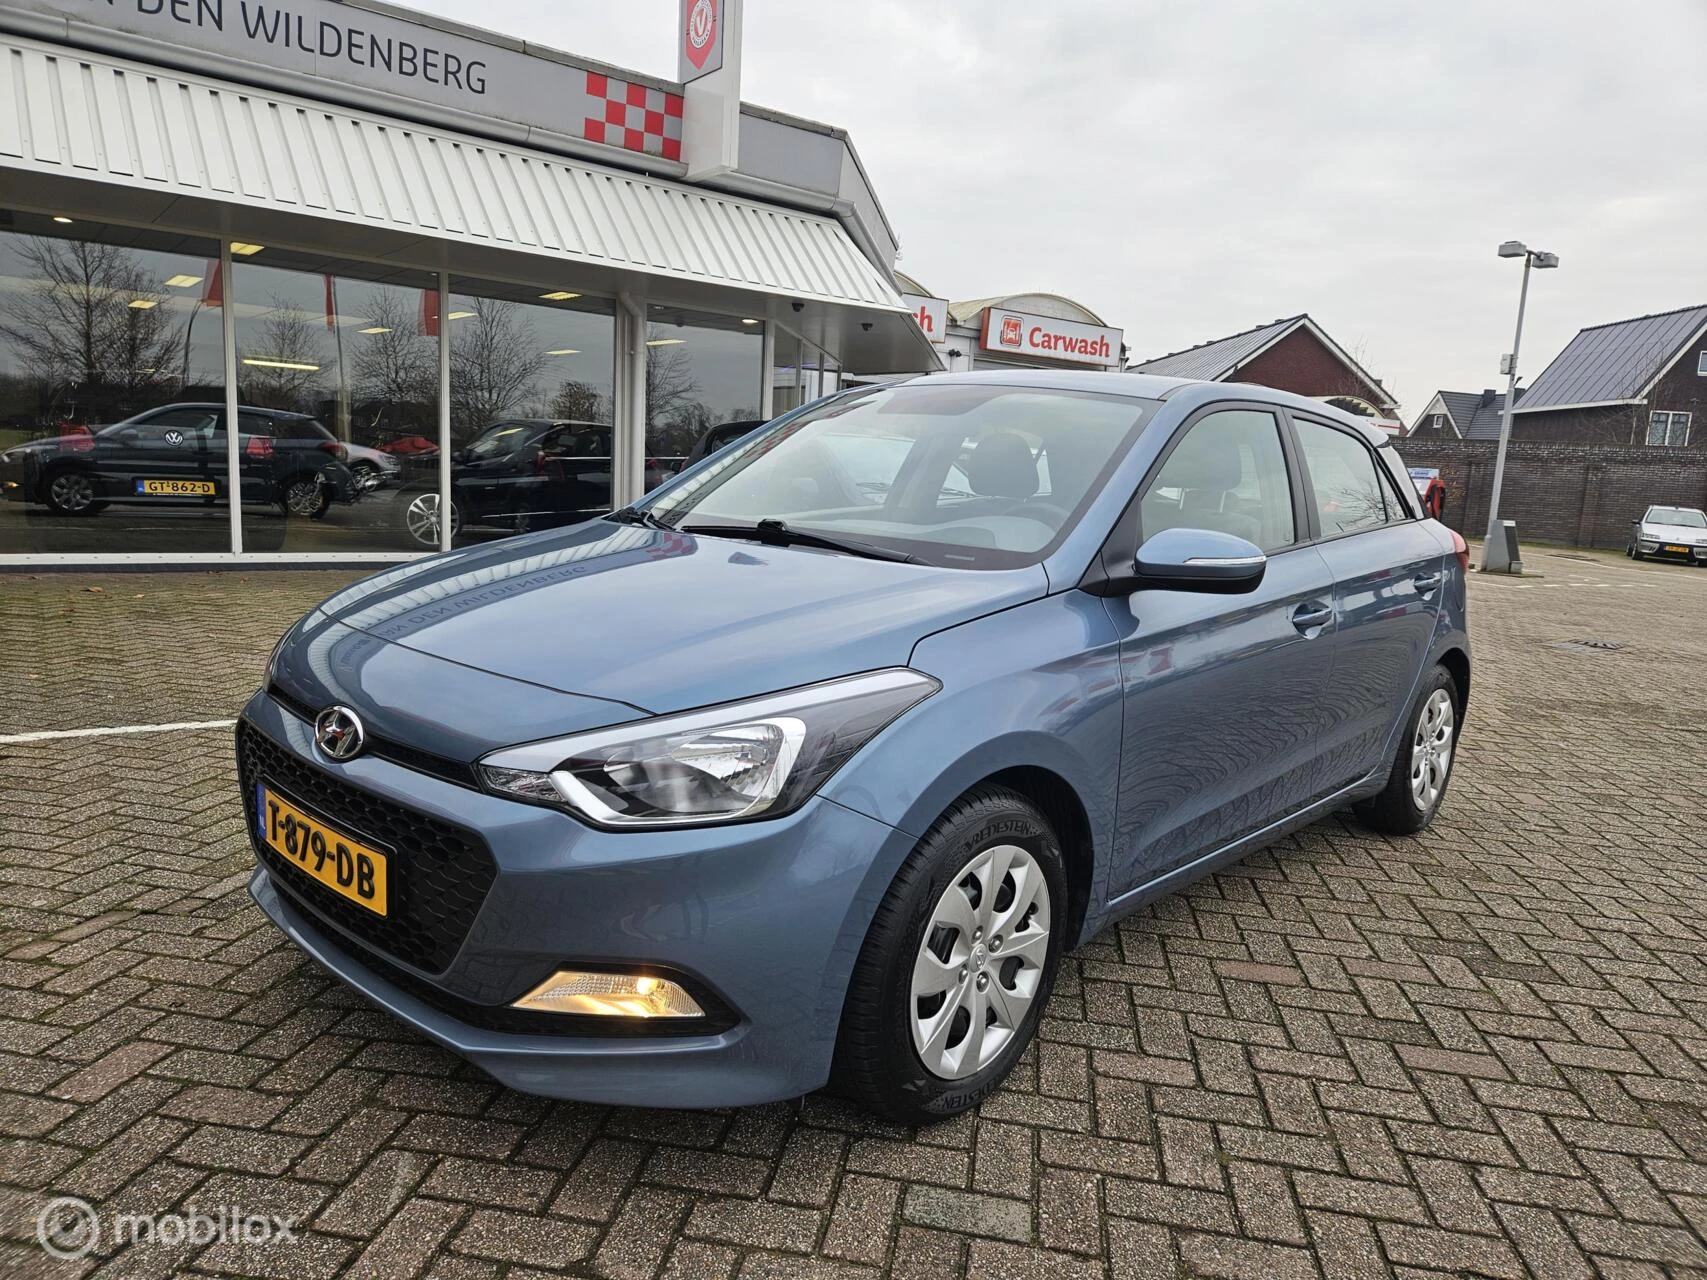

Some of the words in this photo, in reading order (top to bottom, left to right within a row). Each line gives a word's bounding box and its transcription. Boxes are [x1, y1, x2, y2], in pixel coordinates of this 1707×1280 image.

[240, 1, 487, 95] WILDENBERG
[1028, 326, 1110, 358] Carwash
[268, 799, 376, 900] T-879-DB
